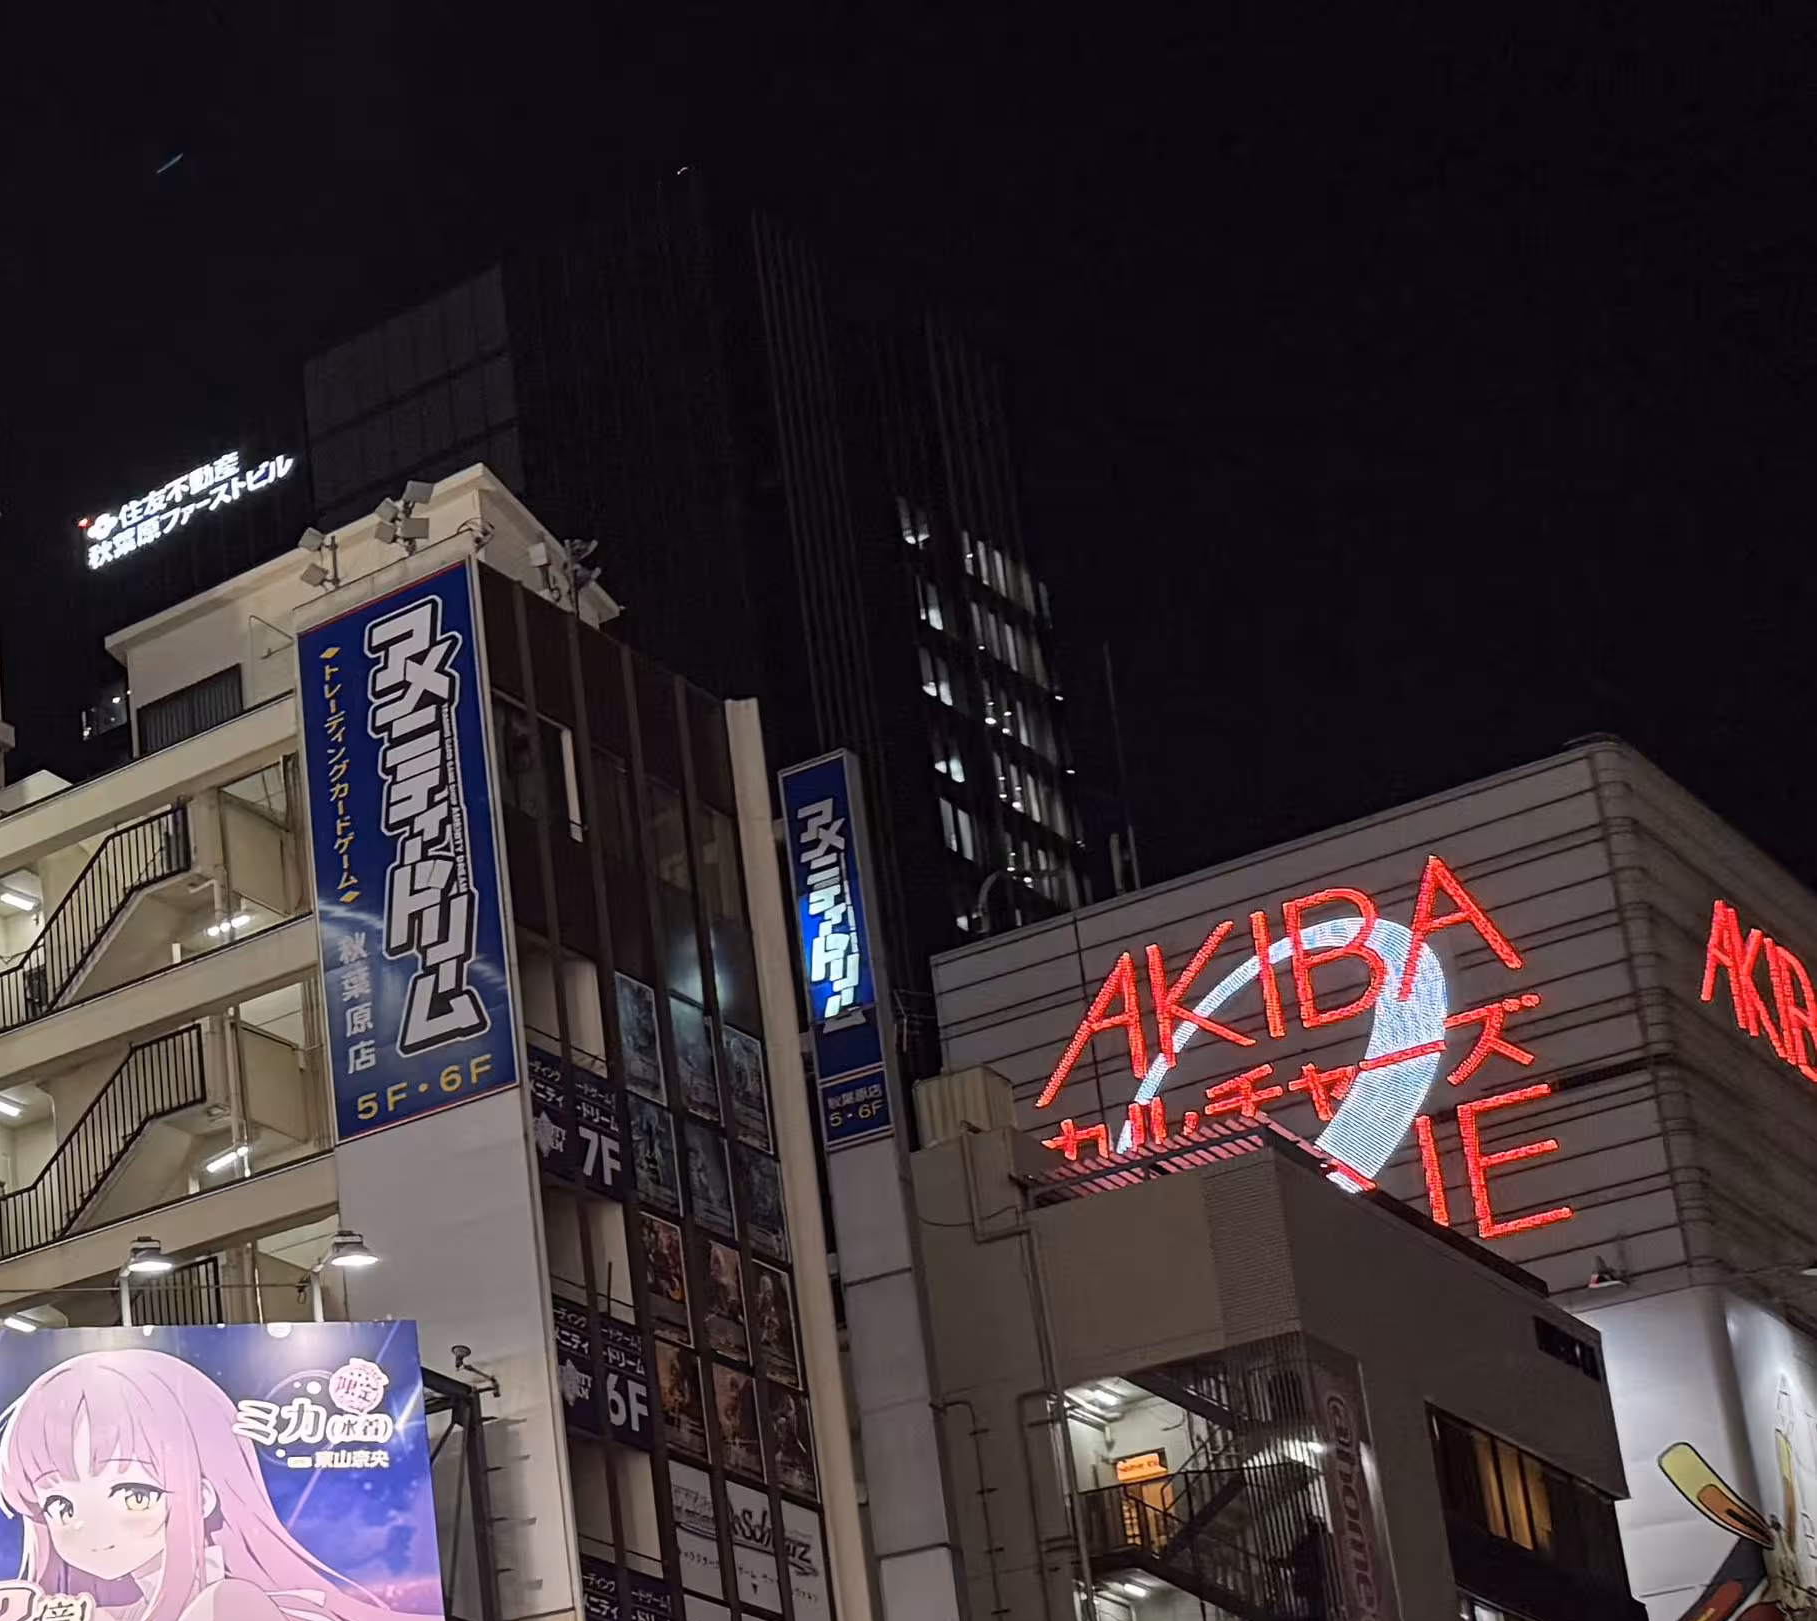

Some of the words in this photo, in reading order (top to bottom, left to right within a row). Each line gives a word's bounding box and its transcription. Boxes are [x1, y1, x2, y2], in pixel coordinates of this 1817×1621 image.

[87, 453, 294, 570] 秋葉原ファーストビル
[119, 451, 240, 528] 住友不動産
[322, 662, 361, 890] トレーディングカードゲーム
[365, 594, 490, 1060] アメニティドリーム
[338, 931, 379, 1075] 秋葉原店
[1036, 854, 1523, 1108] AKIBA
[578, 1125, 622, 1186] 7F
[606, 1372, 649, 1432] 6F
